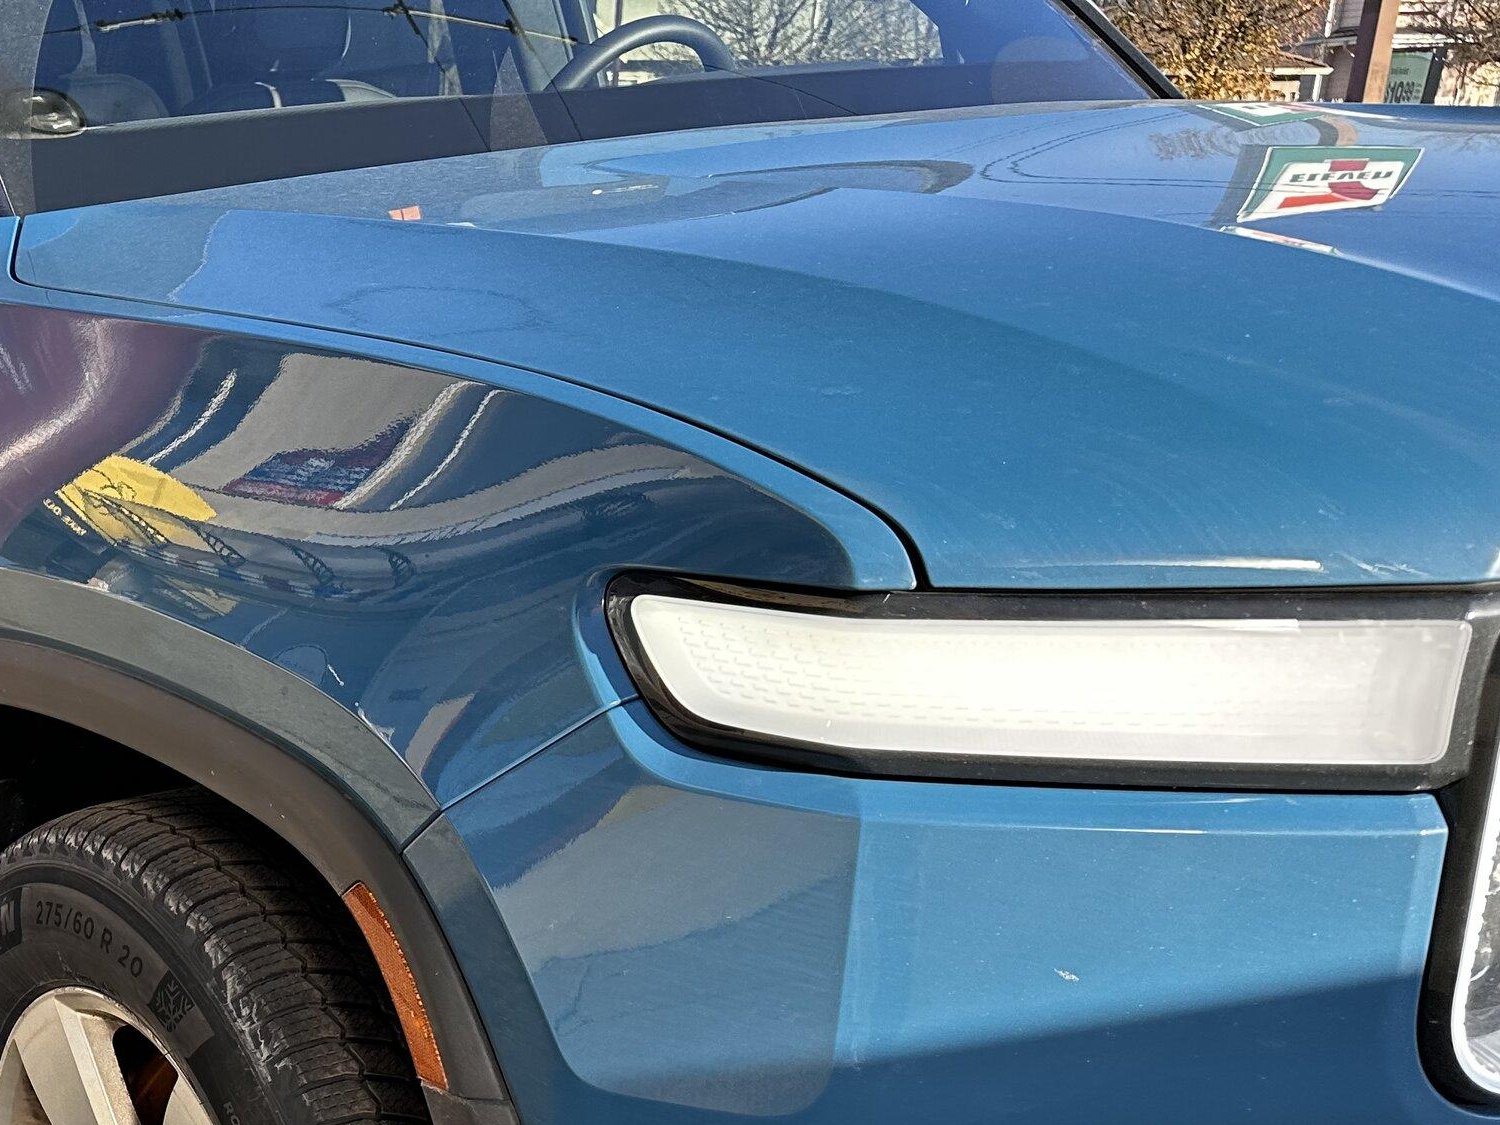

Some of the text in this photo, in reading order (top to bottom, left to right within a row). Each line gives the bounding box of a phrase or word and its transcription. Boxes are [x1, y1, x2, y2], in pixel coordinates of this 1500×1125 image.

[36, 900, 144, 978] 275/60 R 20
